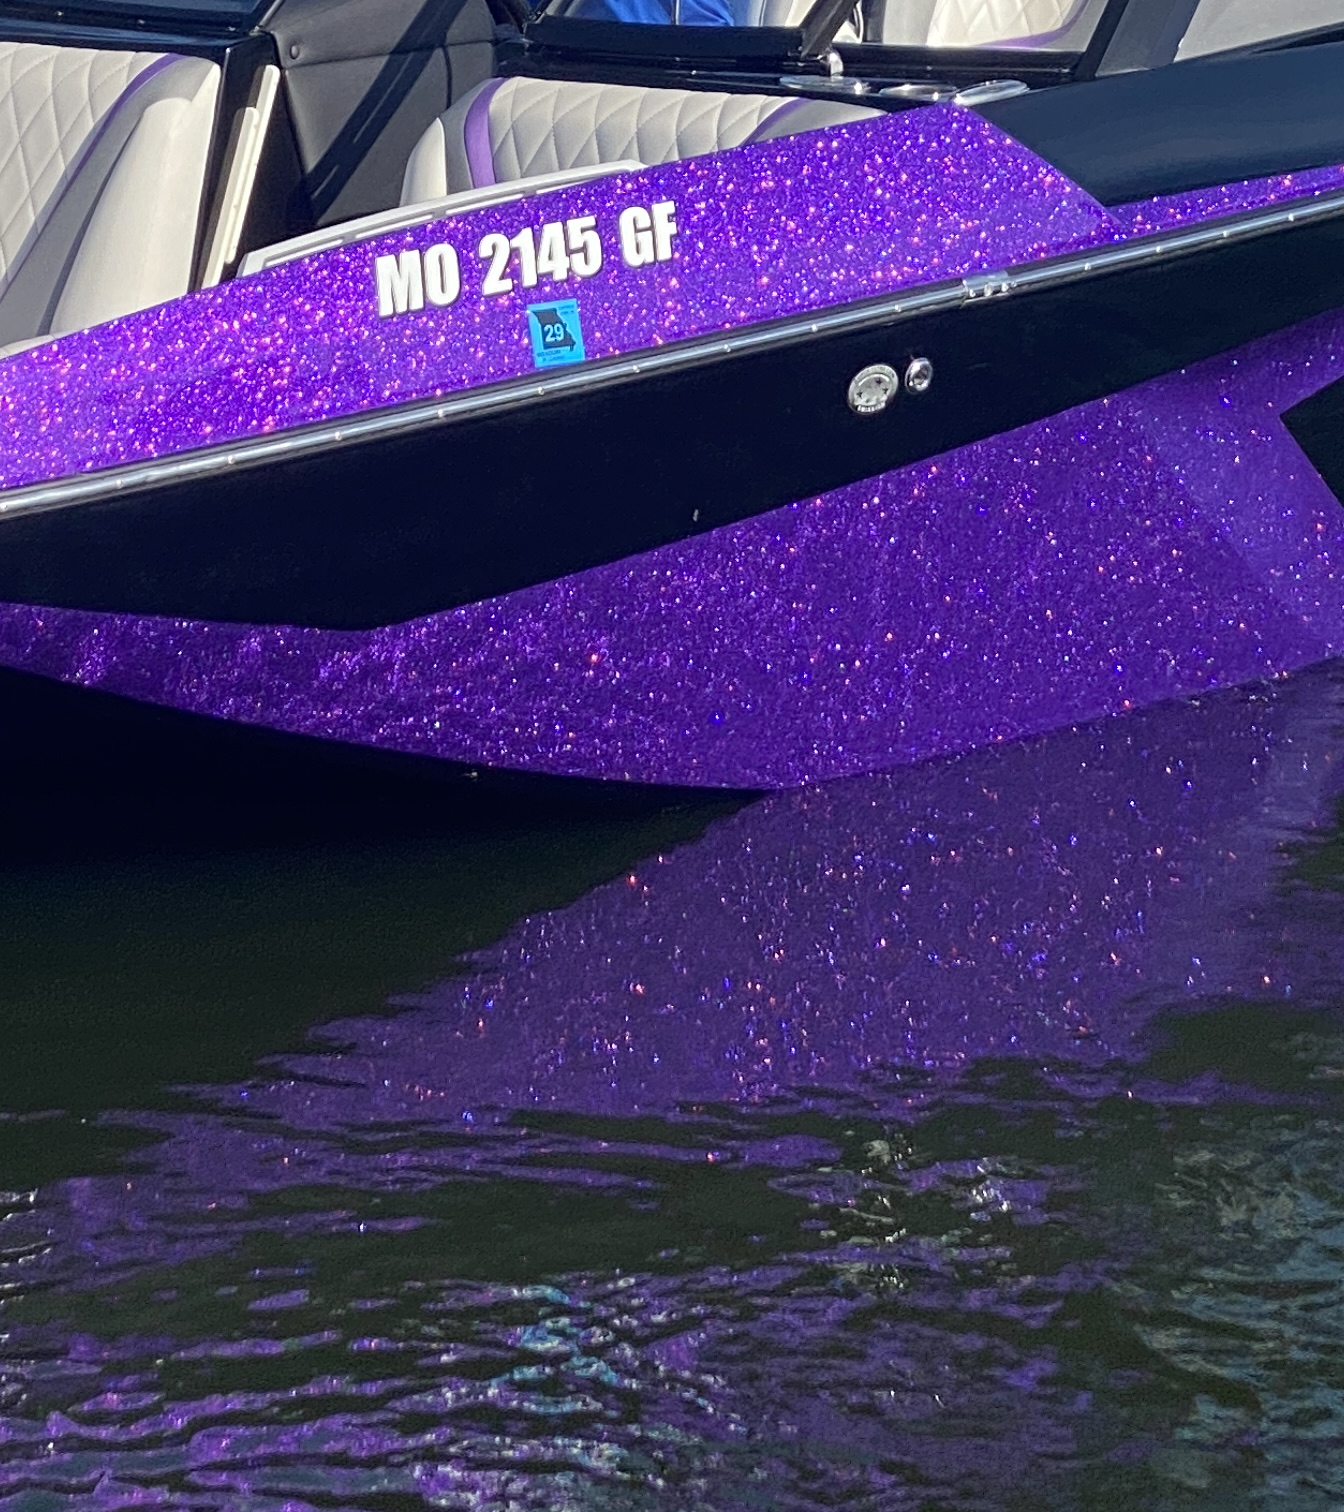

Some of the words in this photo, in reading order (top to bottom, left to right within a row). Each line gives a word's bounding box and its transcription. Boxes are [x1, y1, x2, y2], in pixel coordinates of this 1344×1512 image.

[375, 243, 460, 318] MO
[478, 216, 603, 296] 2145
[619, 200, 678, 267] GF
[543, 323, 565, 342] 29
